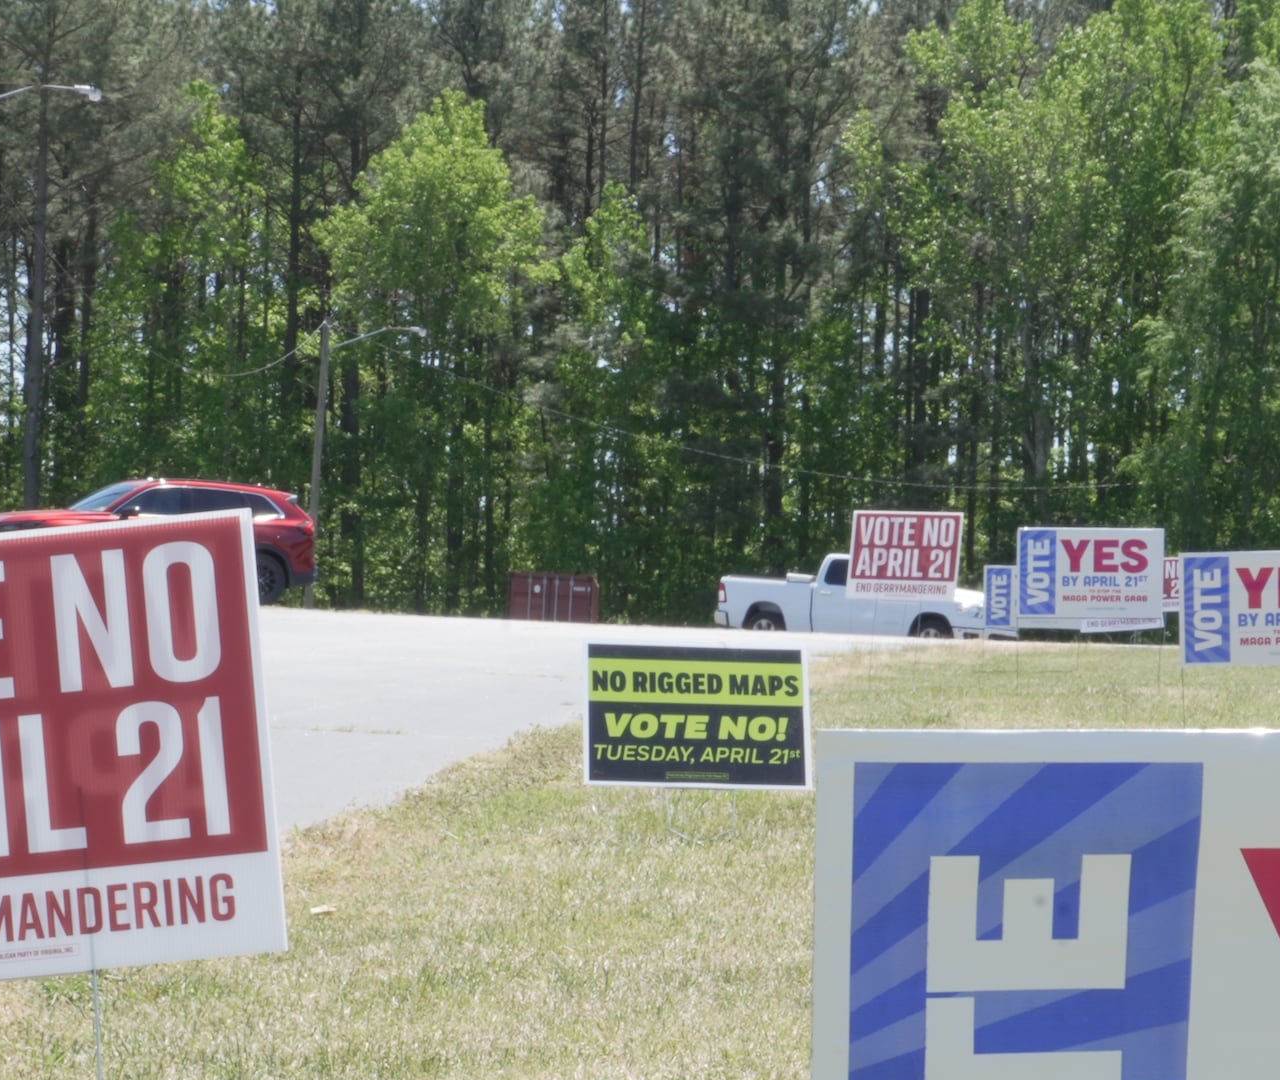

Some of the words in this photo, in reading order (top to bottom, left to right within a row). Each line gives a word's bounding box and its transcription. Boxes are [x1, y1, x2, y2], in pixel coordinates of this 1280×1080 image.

[860, 516, 918, 546] VOTE
[922, 517, 956, 548] NO
[855, 548, 923, 578] APRIL
[928, 549, 952, 578] 21
[1060, 538, 1148, 574] YES
[1165, 561, 1179, 580] N
[1026, 539, 1050, 606] VOTE
[1062, 576, 1078, 587] BY
[1083, 576, 1120, 587] APRIL
[1124, 576, 1148, 587] 21ST
[856, 583, 872, 593] END
[873, 583, 947, 596] GERRYMANDERING
[990, 574, 1008, 620] VOTE
[50, 541, 222, 693] NO
[1193, 568, 1222, 652] VOTE
[1238, 614, 1259, 627] BY
[1240, 637, 1271, 646] MAGA
[592, 670, 626, 692] NO
[632, 672, 723, 694] RIGGED
[729, 674, 800, 696] MAPS
[604, 713, 710, 740] VOTE
[718, 716, 790, 742] NO!
[594, 744, 694, 764] TUESDAY,
[700, 747, 764, 764] APRIL
[768, 748, 800, 764] 21st
[115, 695, 231, 844] 21
